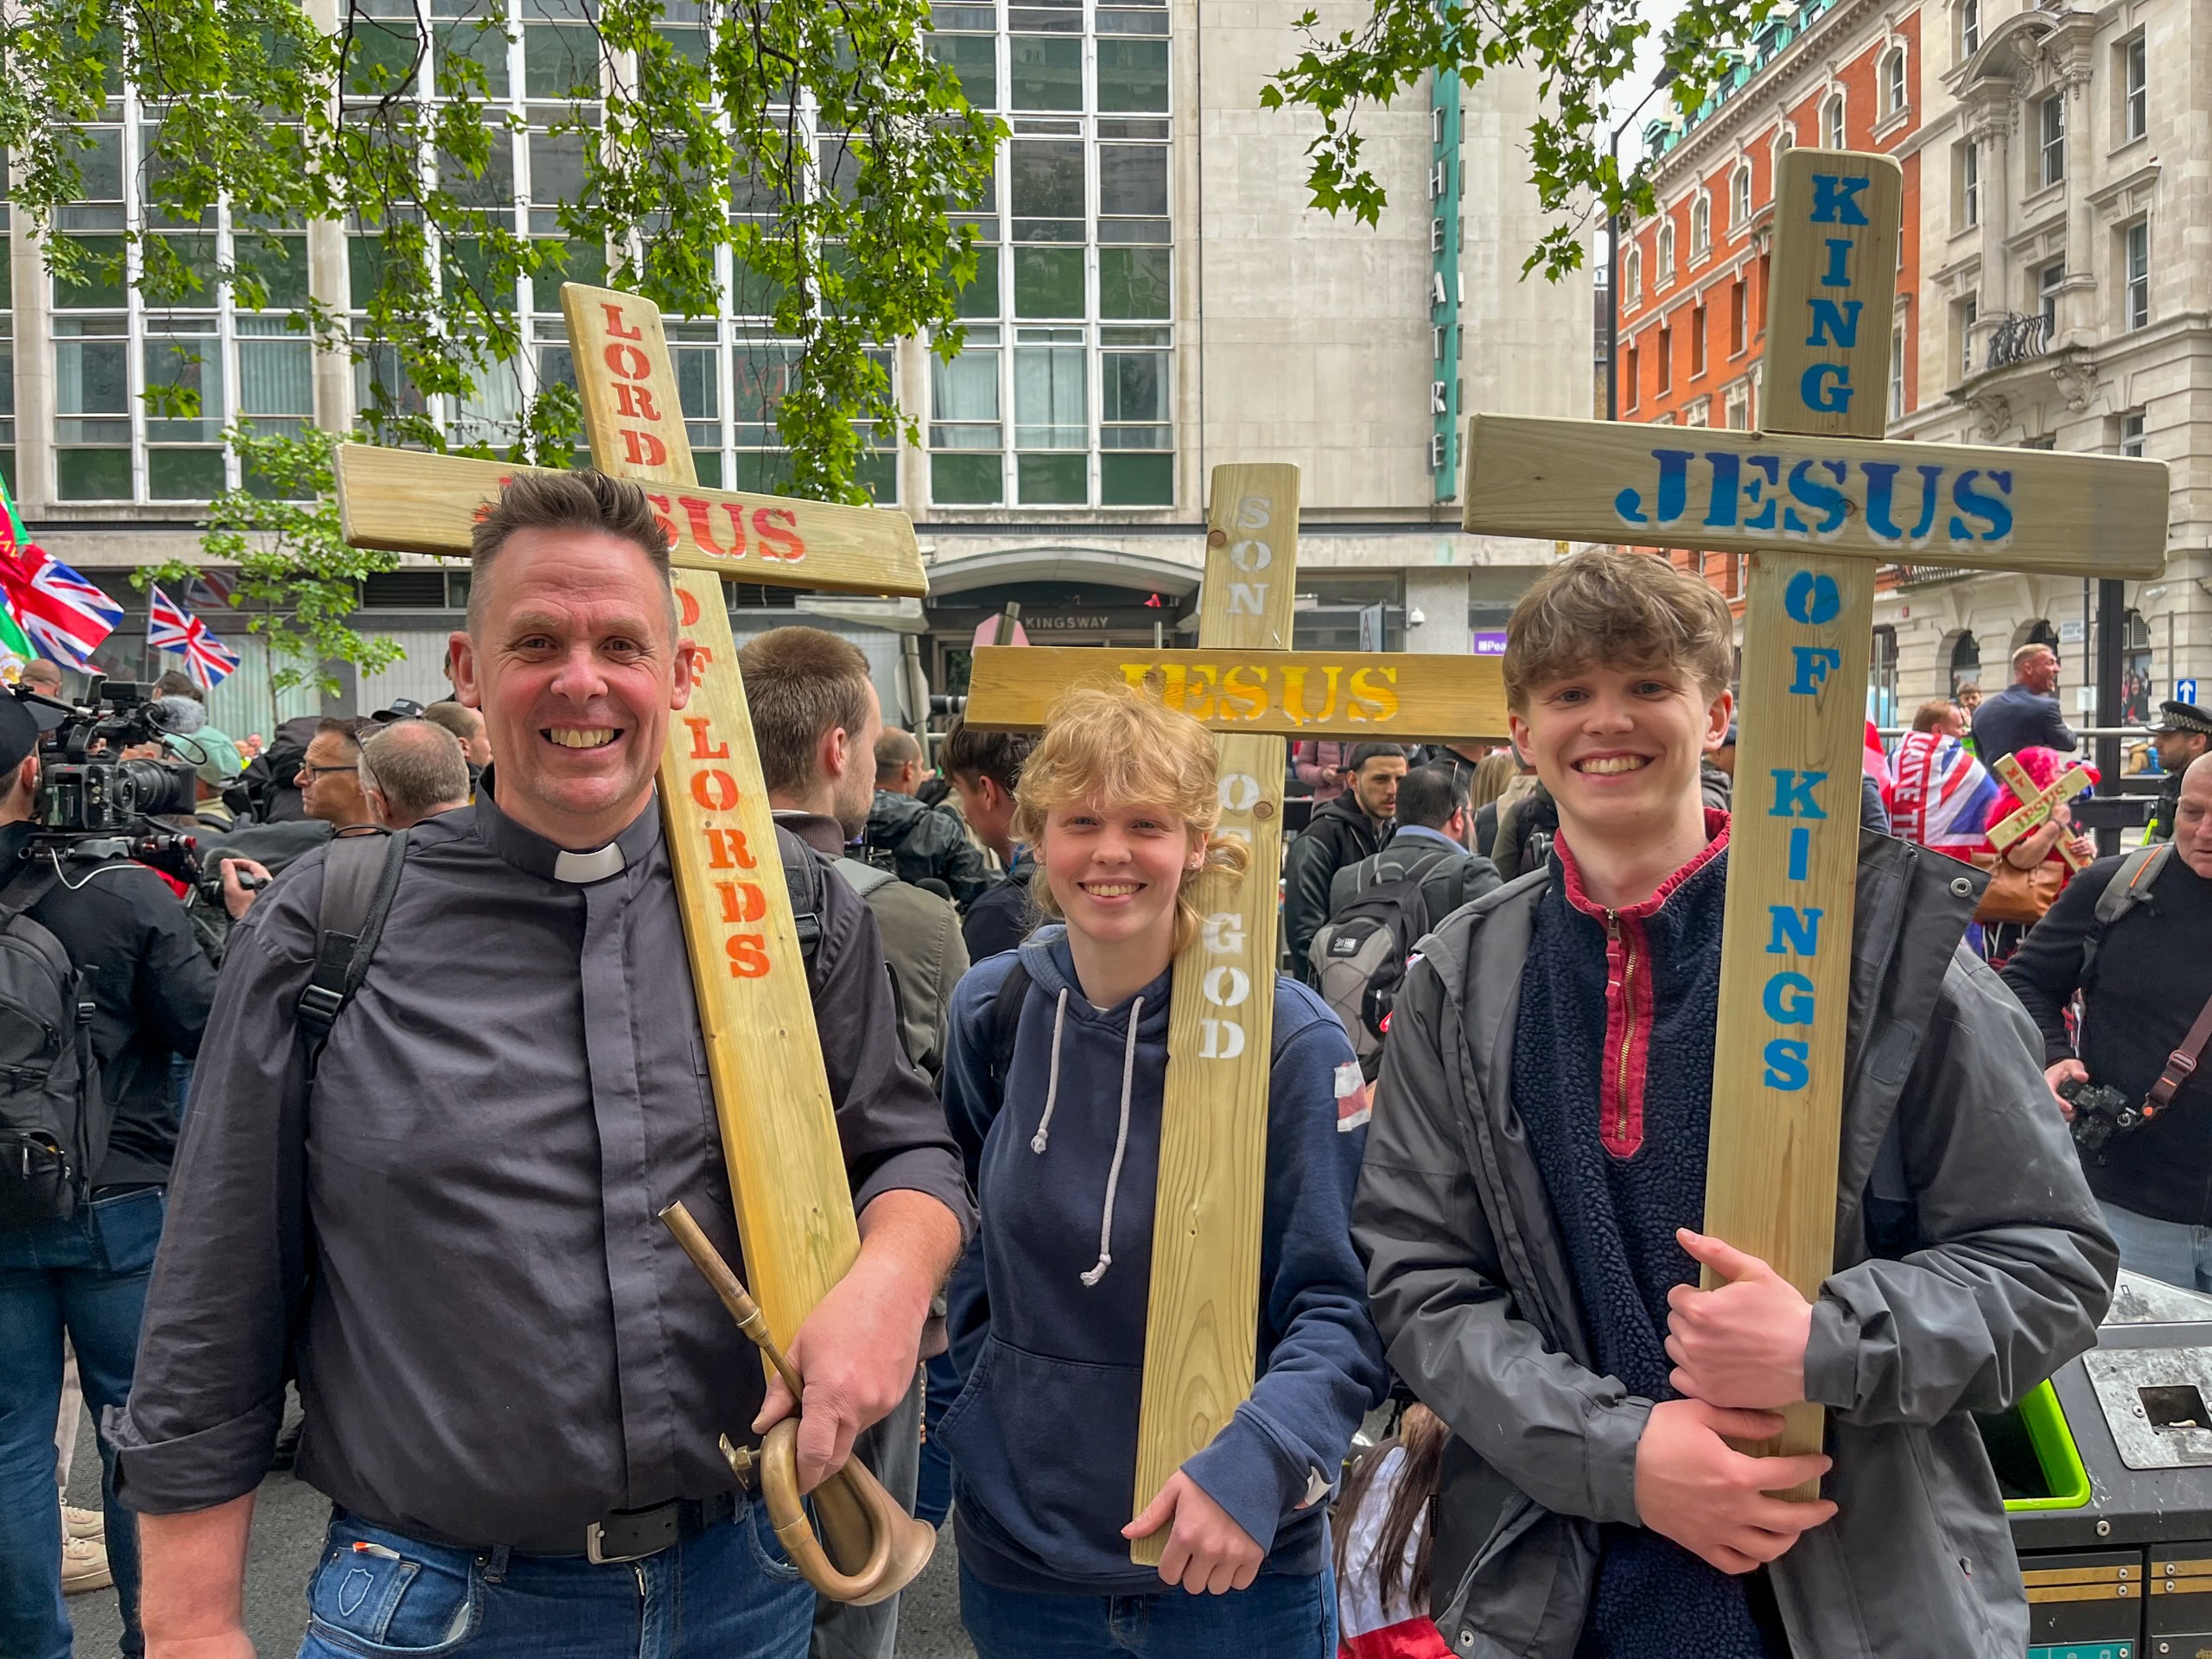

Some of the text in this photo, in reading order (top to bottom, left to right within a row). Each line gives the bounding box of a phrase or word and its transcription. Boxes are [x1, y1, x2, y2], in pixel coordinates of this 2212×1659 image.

[1429, 106, 1446, 468] THEATRE
[1227, 495, 1273, 615] SON
[1614, 448, 2013, 550] JESUS
[600, 303, 666, 467] LORD
[683, 716, 770, 978] LORDS
[1026, 616, 1109, 628] KINGSWAY
[1763, 174, 1870, 1091] KING OF KINGS
[1198, 912, 1250, 1059] GOD
